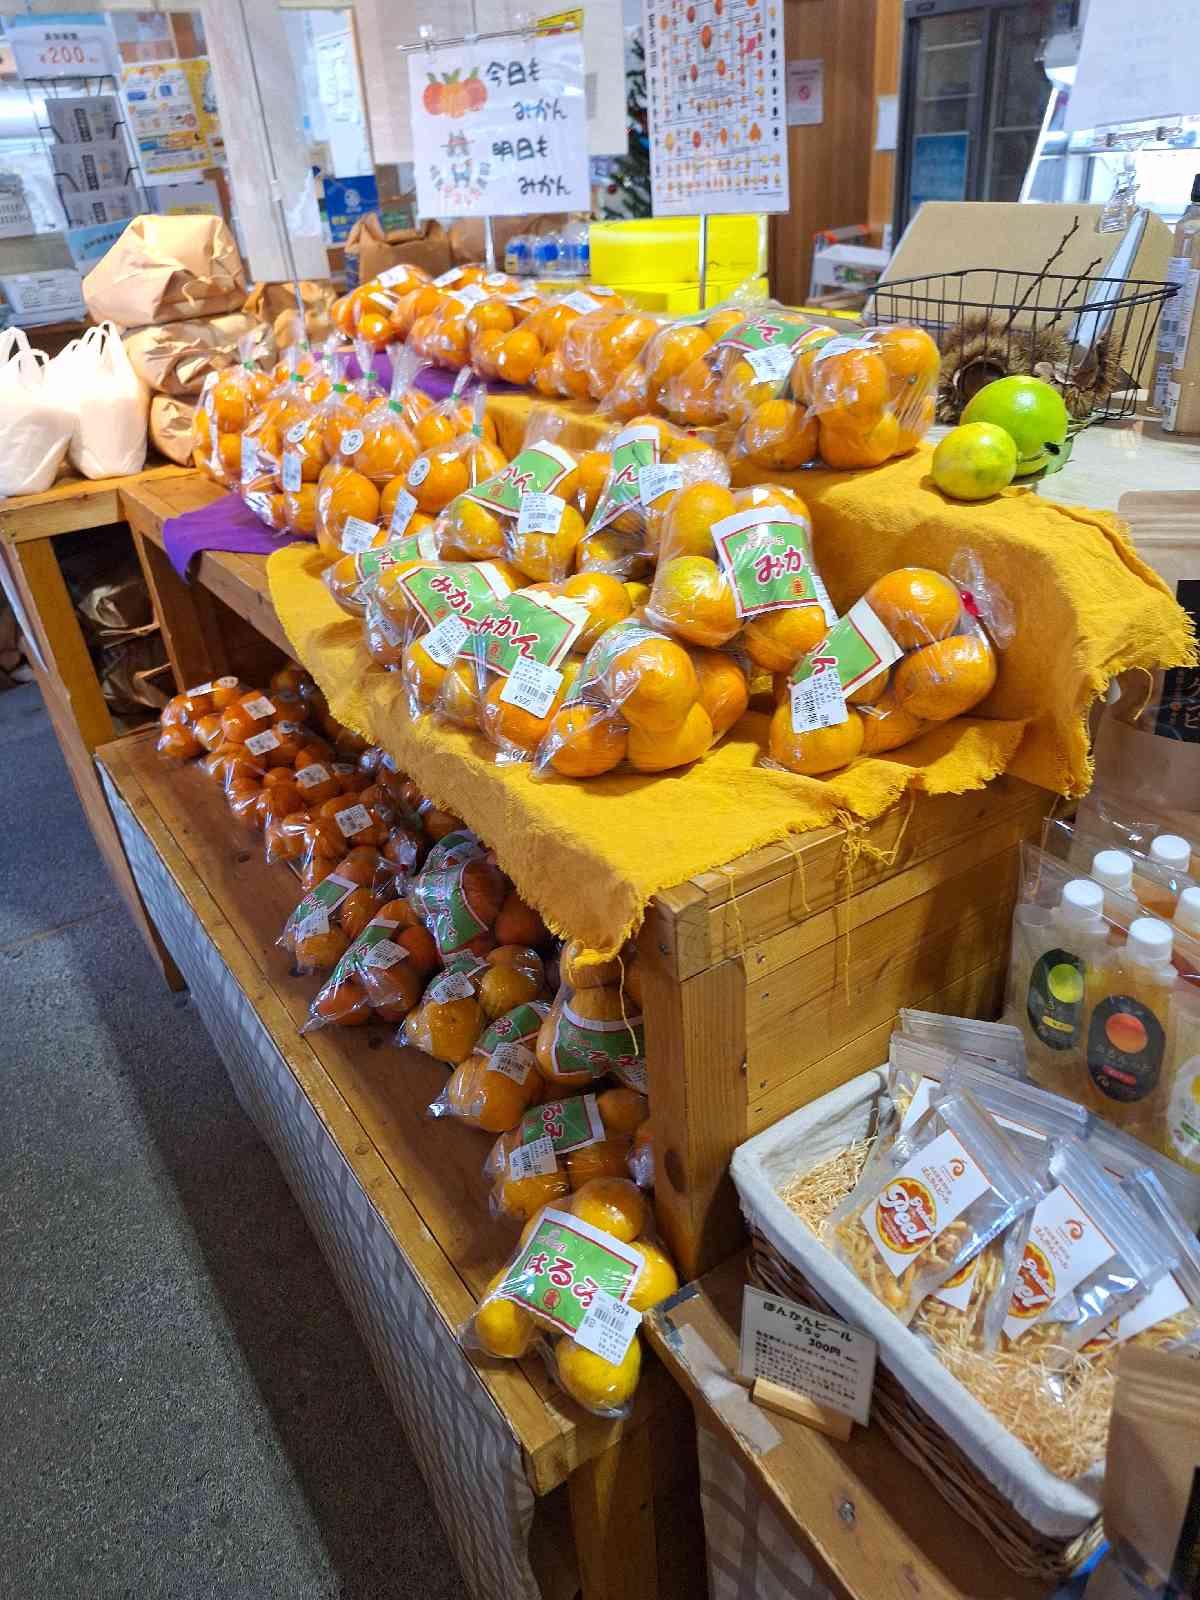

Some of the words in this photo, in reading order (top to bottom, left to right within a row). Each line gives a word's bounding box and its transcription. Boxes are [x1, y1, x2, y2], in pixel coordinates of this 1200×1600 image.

[486, 57, 540, 87] 今日も
[513, 98, 568, 121] みかん
[491, 135, 549, 161] 明日も
[518, 175, 573, 196] みかん
[521, 1250, 602, 1310] はるみ
[808, 1338, 841, 1357] 300円
